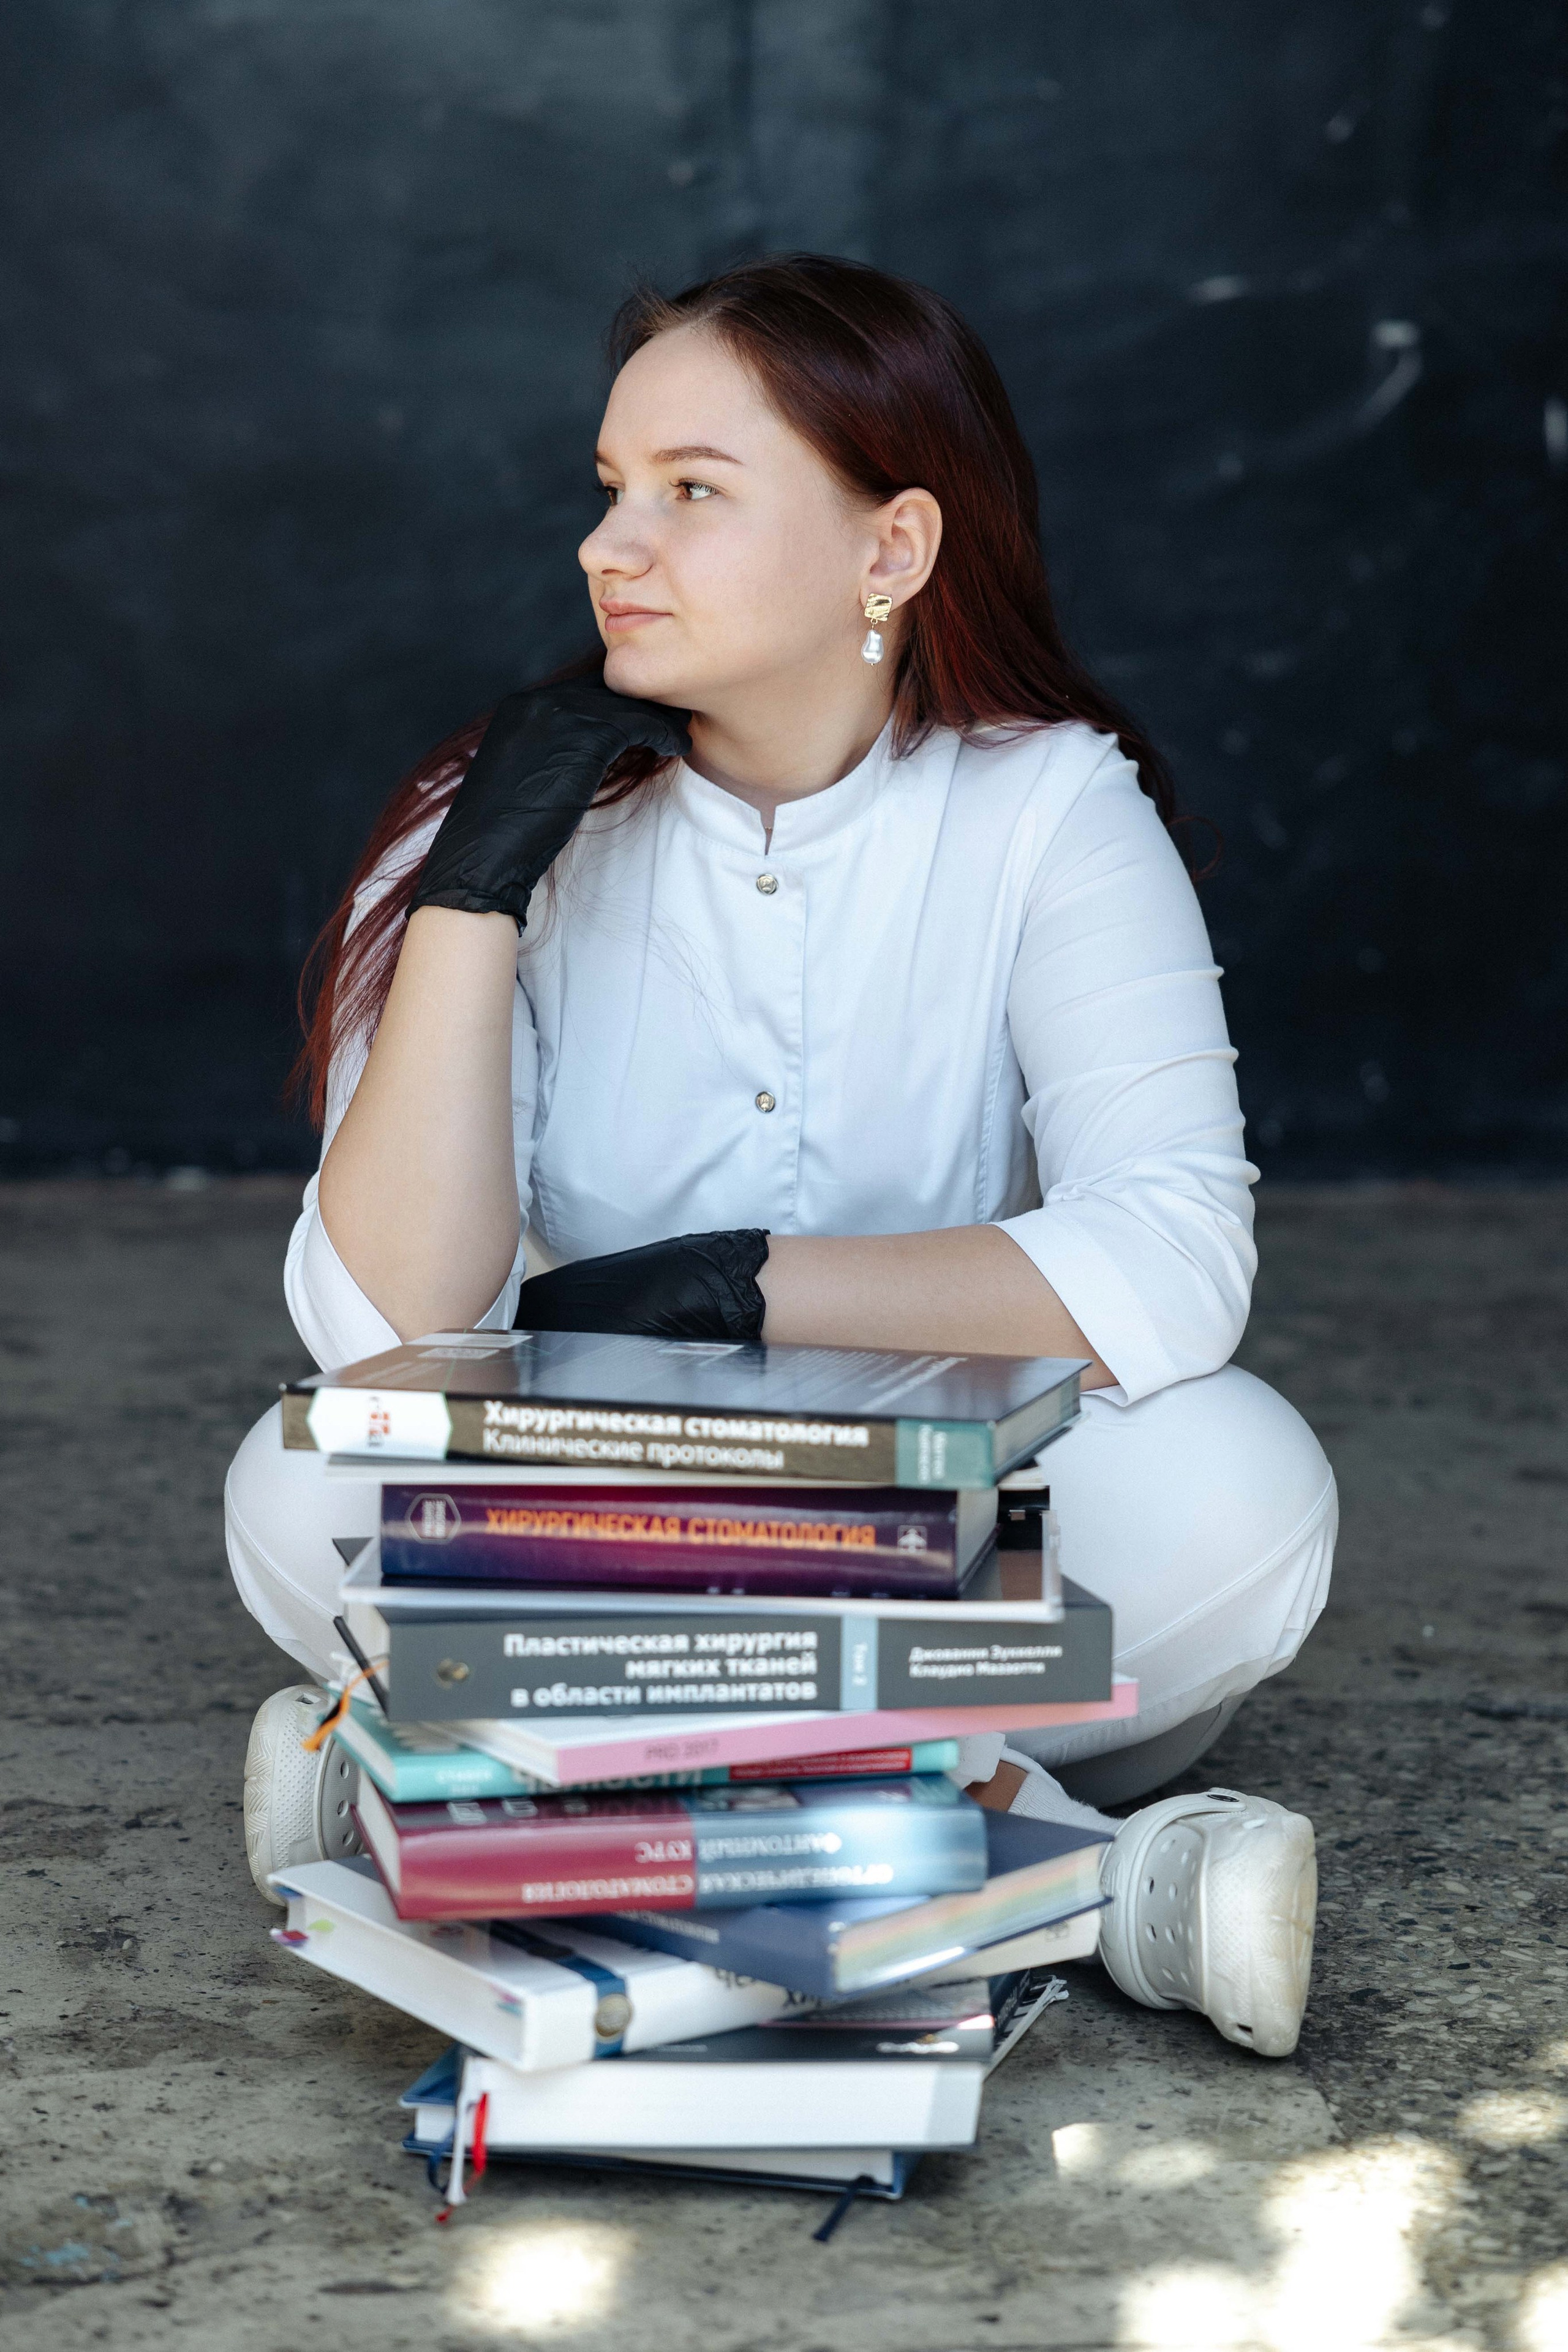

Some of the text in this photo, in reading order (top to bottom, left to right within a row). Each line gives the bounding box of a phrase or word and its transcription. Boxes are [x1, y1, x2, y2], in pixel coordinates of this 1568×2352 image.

[483, 1401, 870, 1447] Хирургическая стоматология
[483, 1428, 784, 1469] Клинические протоколы
[486, 1508, 681, 1544] ХИРУРГИЧЕСКАЯ
[688, 1517, 876, 1551] СТОМАТОЛОГИЯ
[504, 1631, 818, 1656] Пластическая хирургия
[625, 1651, 818, 1679] мягких тканей
[510, 1681, 818, 1708] в области имплантатов
[635, 1839, 693, 1863] КУРС
[522, 1874, 694, 1903] СТОМАТОЛОГИЯ
